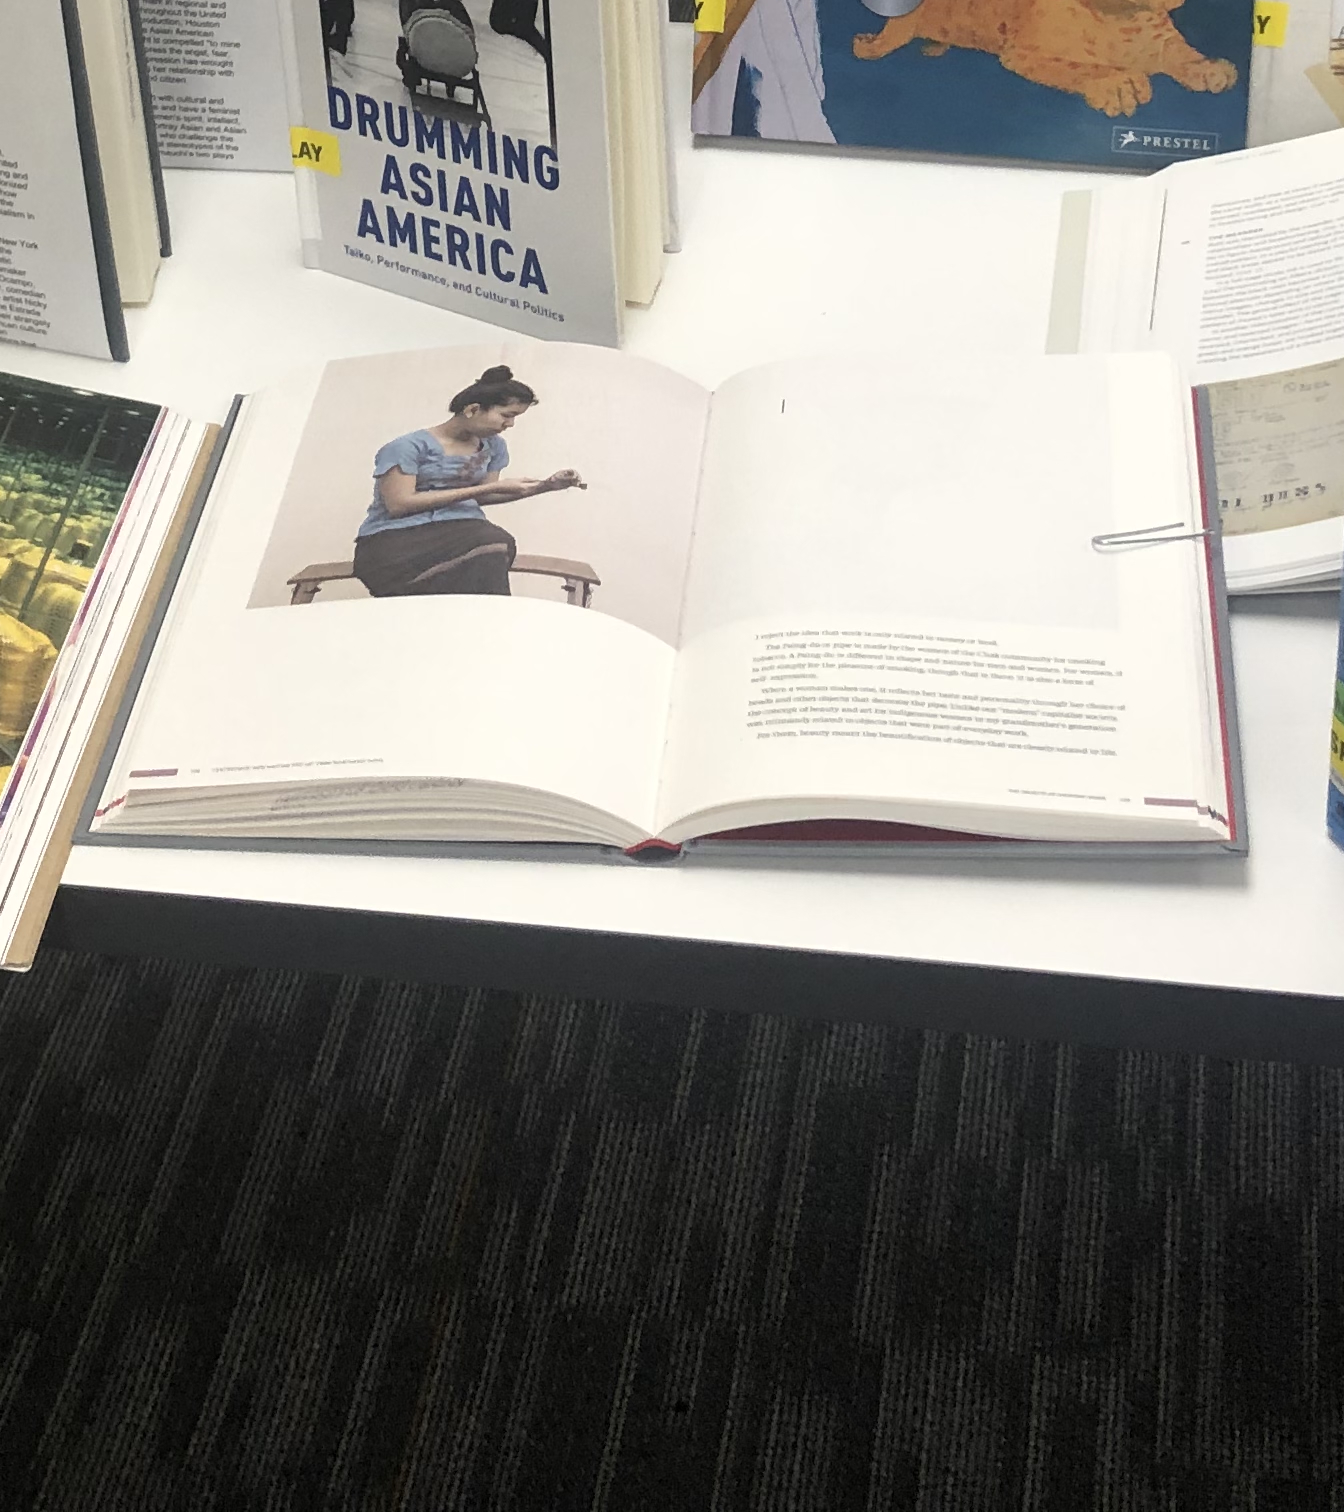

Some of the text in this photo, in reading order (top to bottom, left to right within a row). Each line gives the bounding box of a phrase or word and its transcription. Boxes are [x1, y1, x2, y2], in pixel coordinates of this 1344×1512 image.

[327, 86, 560, 192] DRUMMING
[1142, 135, 1212, 151] PRESTEL
[380, 154, 512, 232] ASIAN
[344, 244, 565, 323] Taiko, Performance, and Cultural Politics
[357, 198, 549, 295] AMERICA
